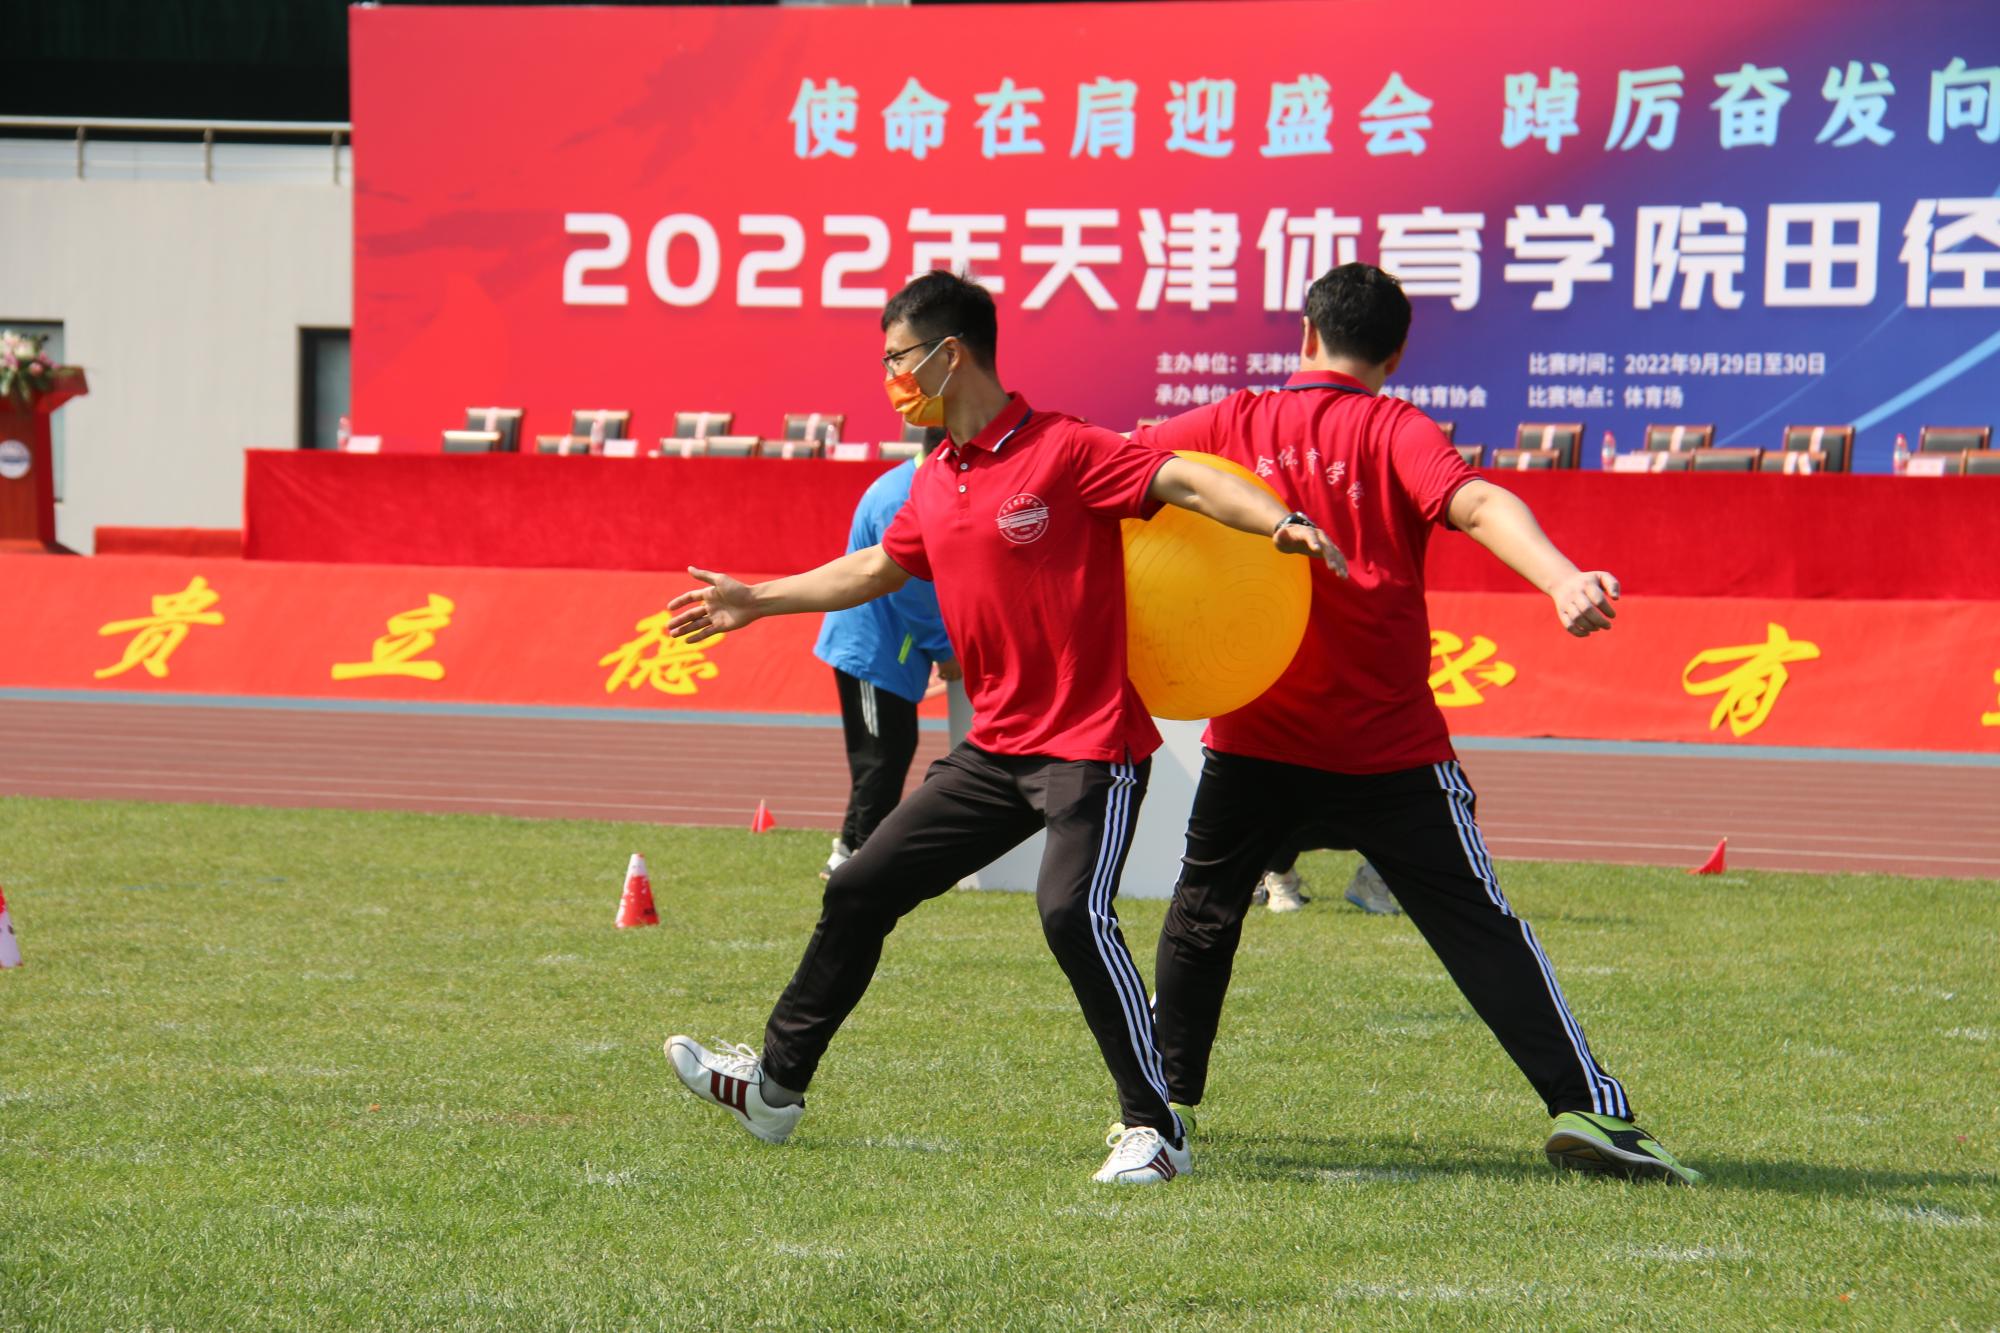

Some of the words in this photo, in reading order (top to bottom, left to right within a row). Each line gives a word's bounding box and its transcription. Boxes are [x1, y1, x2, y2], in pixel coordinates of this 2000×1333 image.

[788, 72, 1434, 160] 使命在肩迎盛会
[1500, 56, 2000, 154] 踔厉奋发向
[562, 198, 2000, 311] 2022年天津体育学院田径
